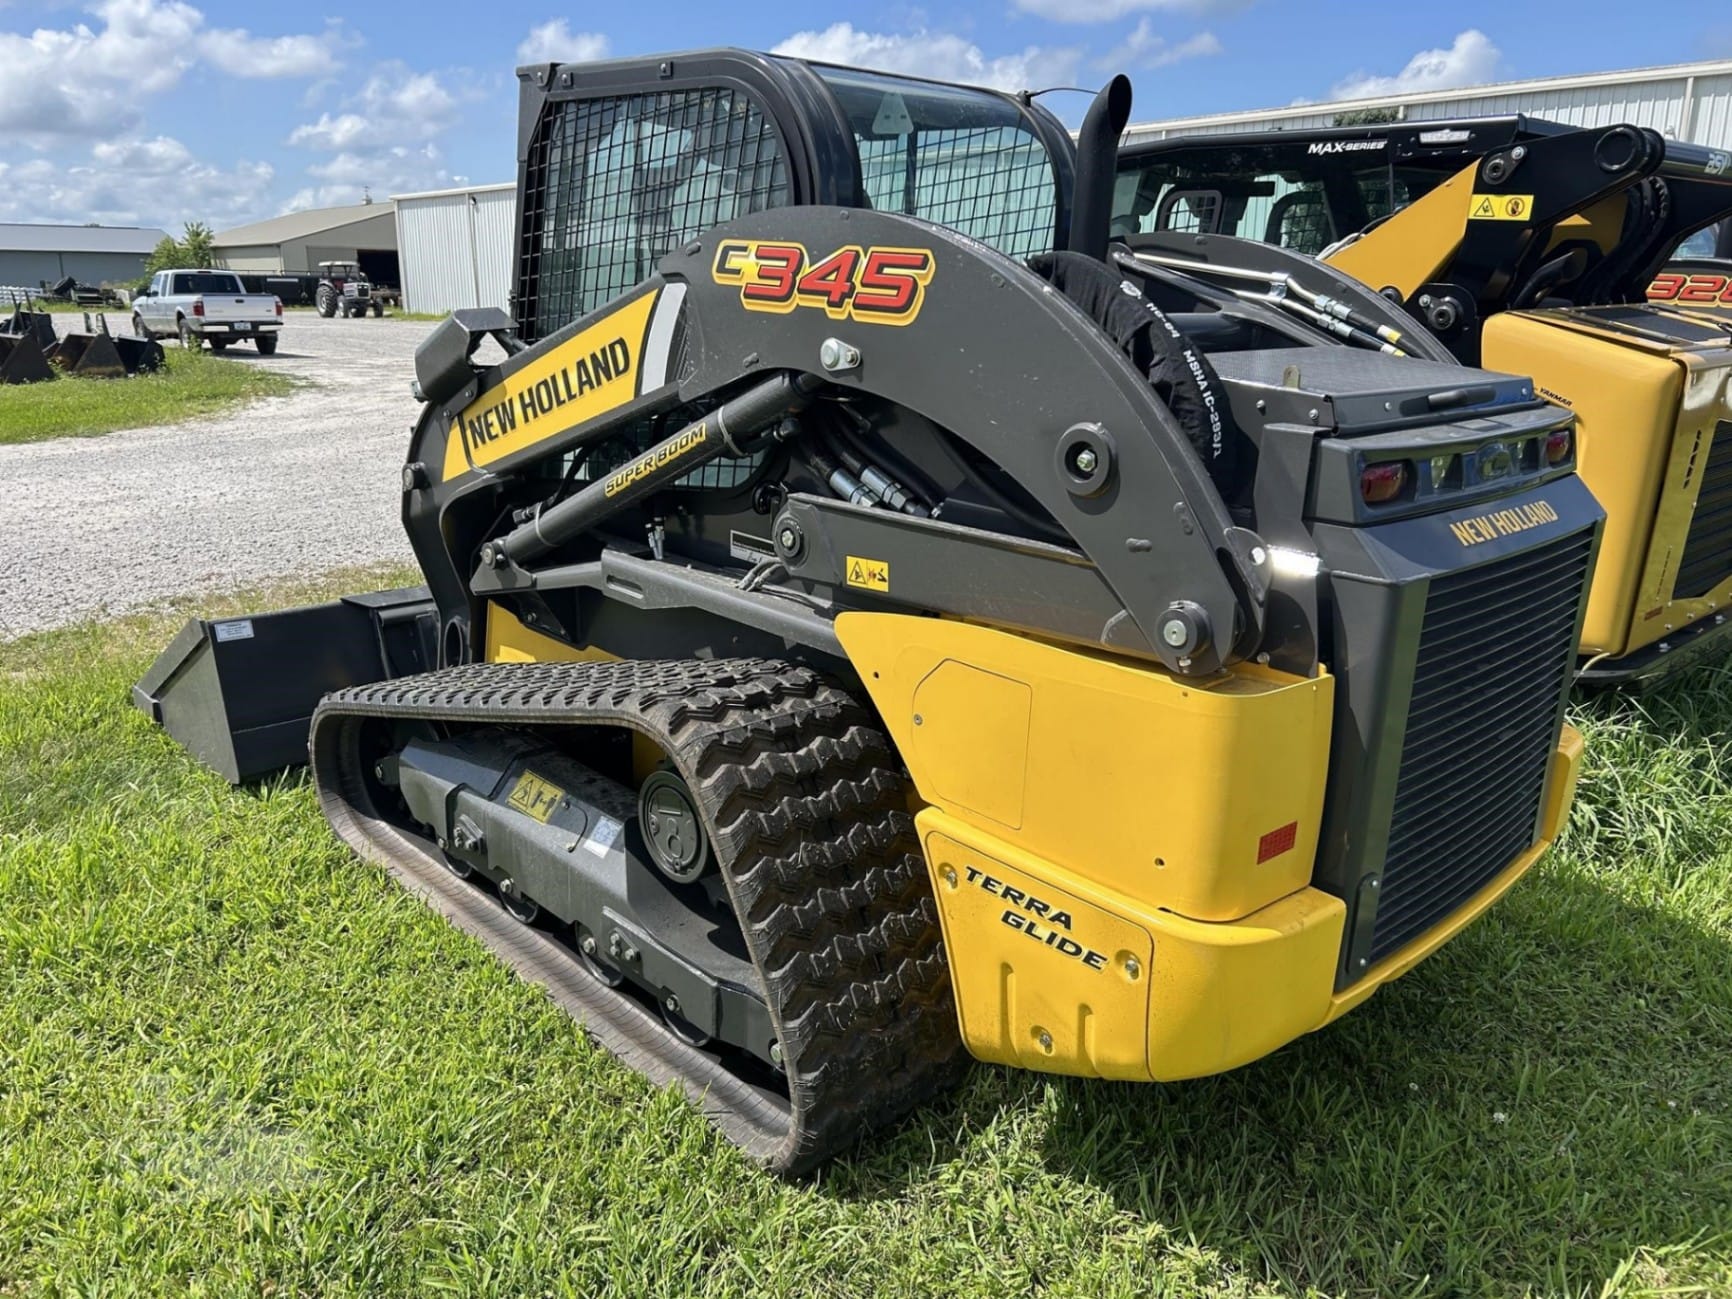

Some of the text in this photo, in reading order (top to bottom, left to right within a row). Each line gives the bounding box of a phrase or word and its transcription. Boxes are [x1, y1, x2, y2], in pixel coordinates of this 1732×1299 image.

[713, 240, 935, 326] C345
[467, 336, 630, 449] NEW HOLLAND
[1183, 350, 1208, 391] MSHA
[605, 422, 706, 497] SUPER BOOM
[1449, 500, 1559, 547] NEW HOLLAND
[966, 866, 1072, 931] TERRA
[1001, 910, 1108, 970] GLIDE
